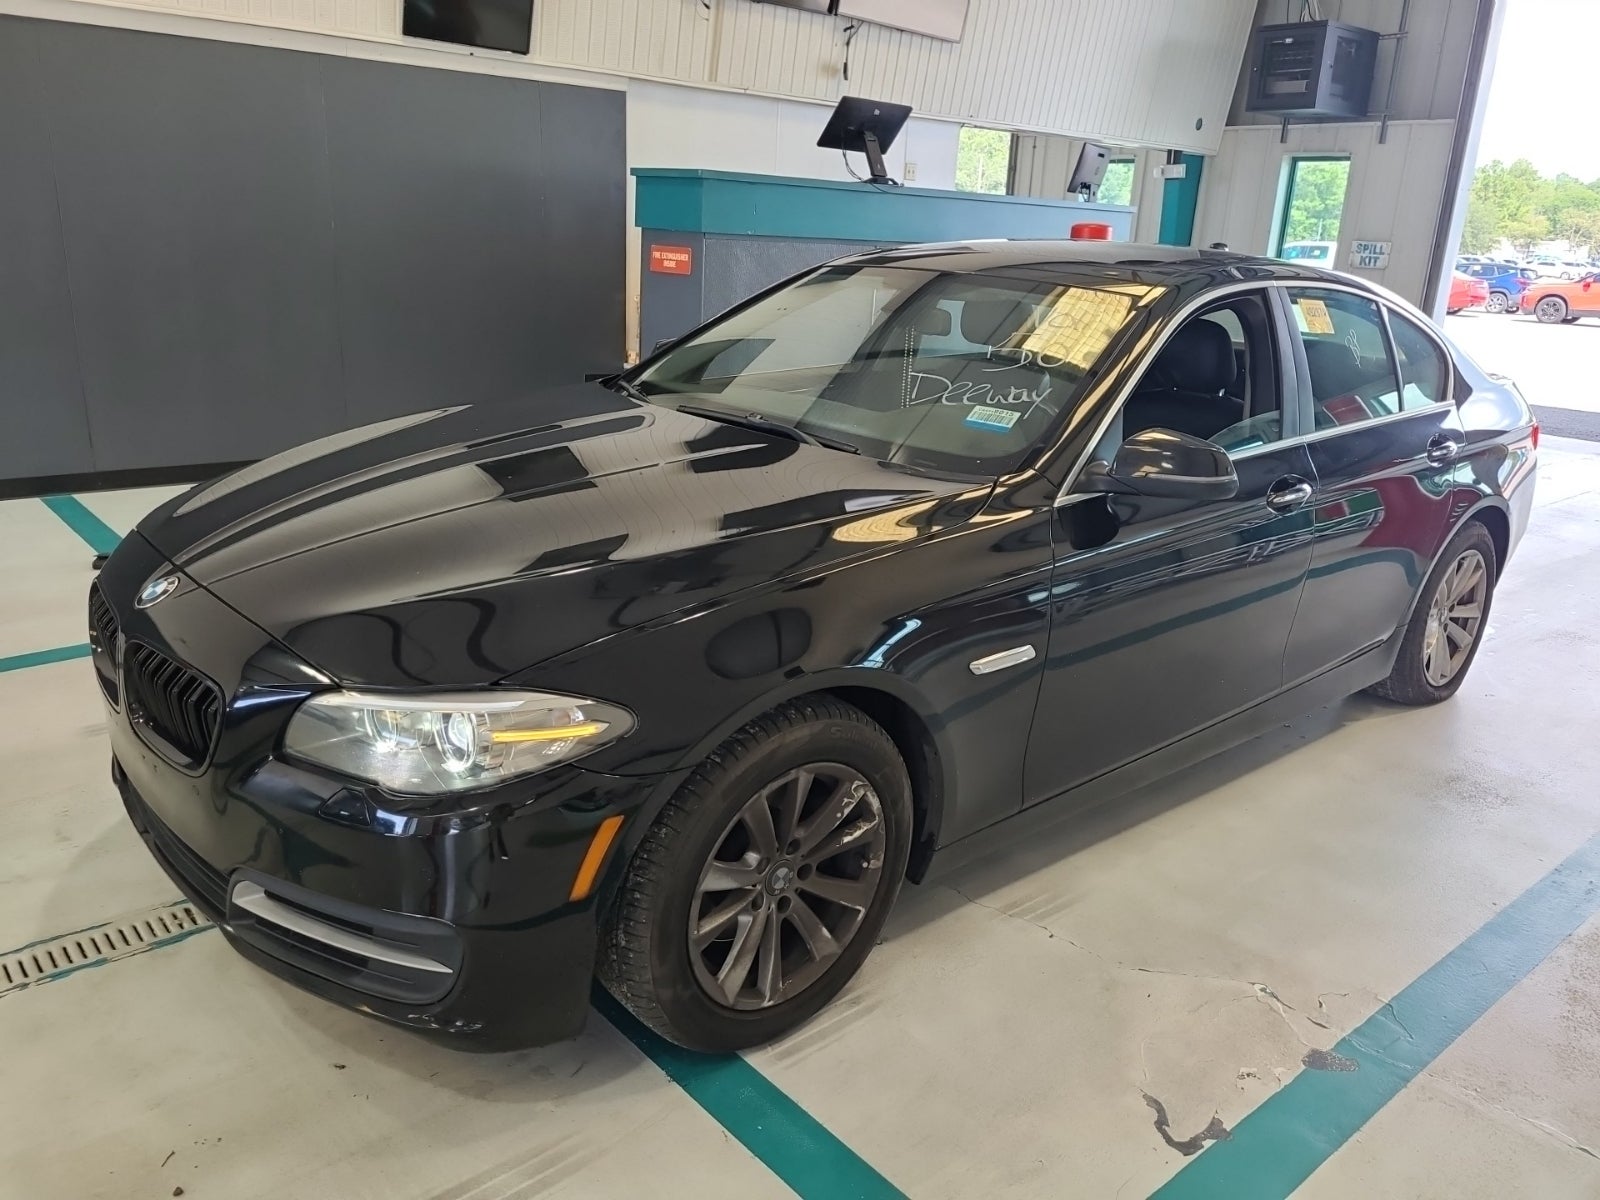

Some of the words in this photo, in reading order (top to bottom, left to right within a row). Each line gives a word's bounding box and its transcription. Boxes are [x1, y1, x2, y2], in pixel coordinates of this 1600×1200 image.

[1355, 243, 1385, 255] SPILL
[652, 251, 661, 259] FIRE
[661, 252, 689, 261] EXTINGUISHER
[1359, 255, 1380, 267] KIT
[663, 259, 677, 268] INSIDE
